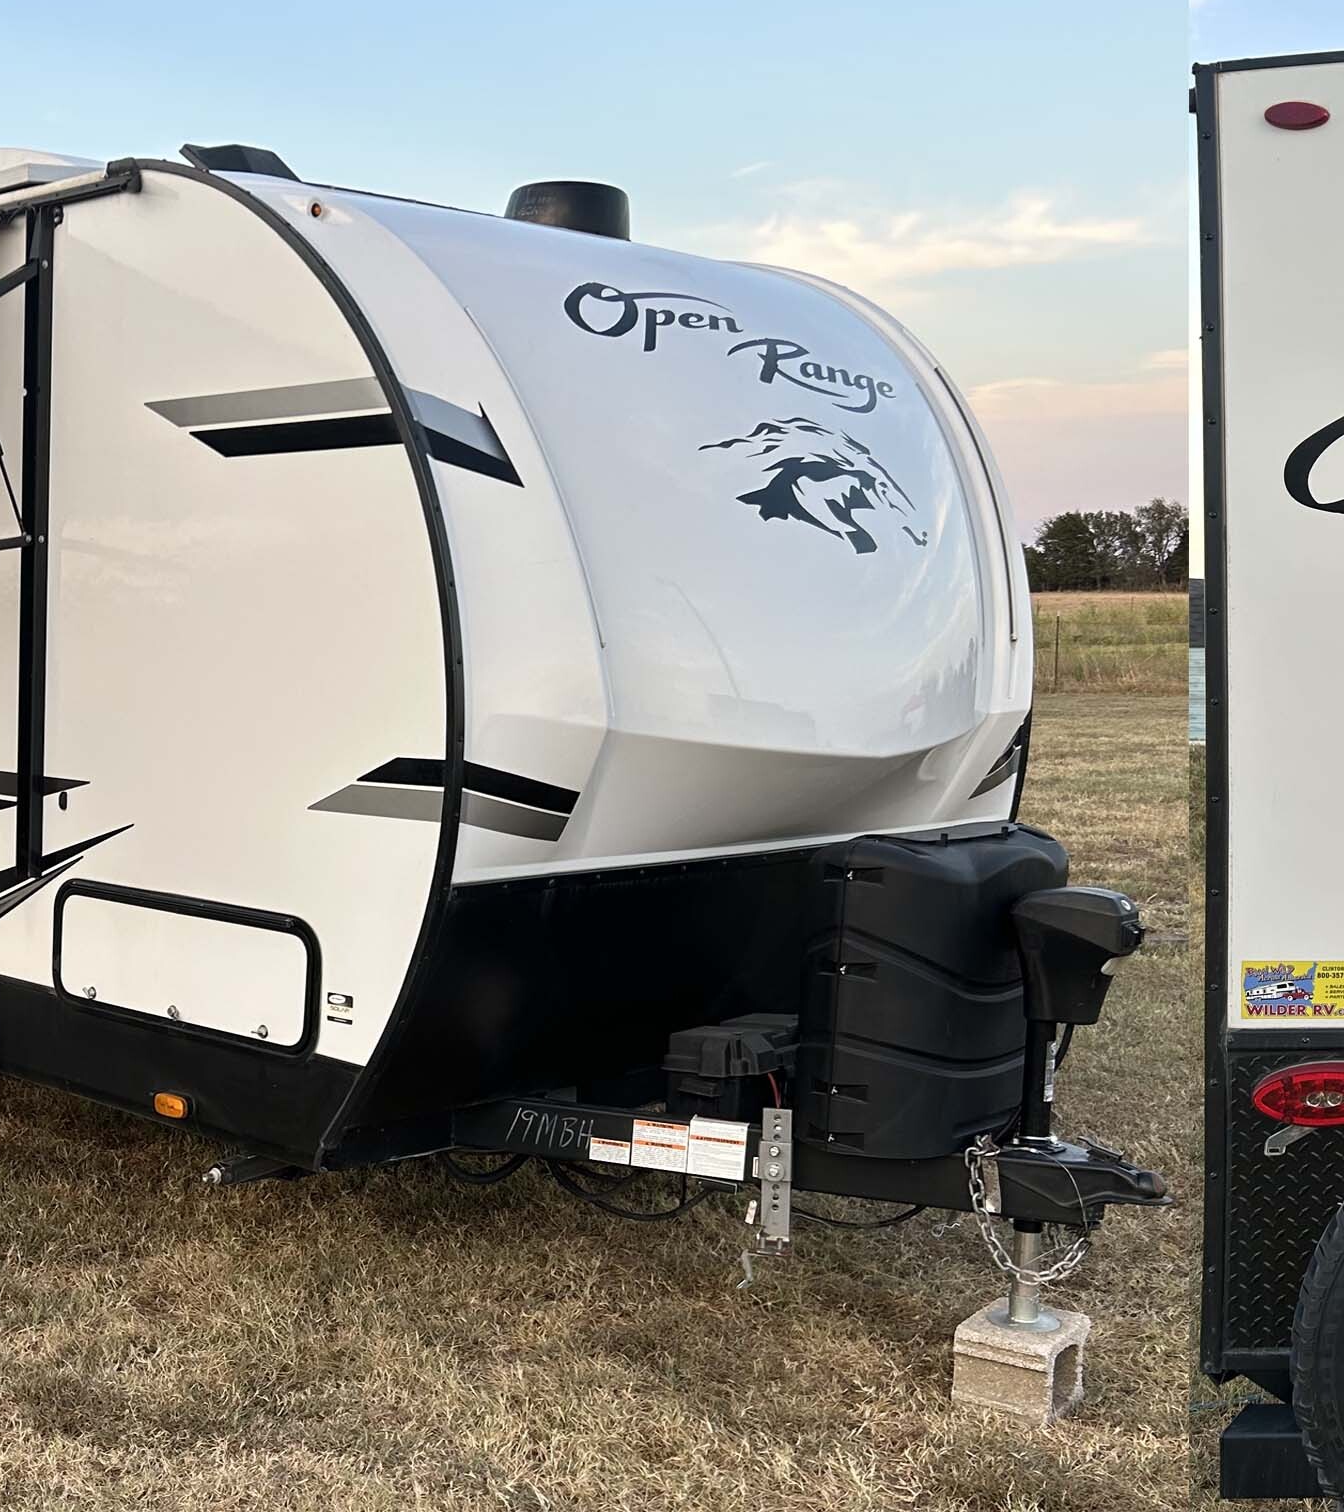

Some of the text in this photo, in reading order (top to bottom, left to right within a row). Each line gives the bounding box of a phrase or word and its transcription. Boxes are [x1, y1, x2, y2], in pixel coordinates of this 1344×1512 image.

[564, 282, 744, 353] Open
[727, 338, 897, 414] Range
[1246, 1004, 1307, 1016] WILDER
